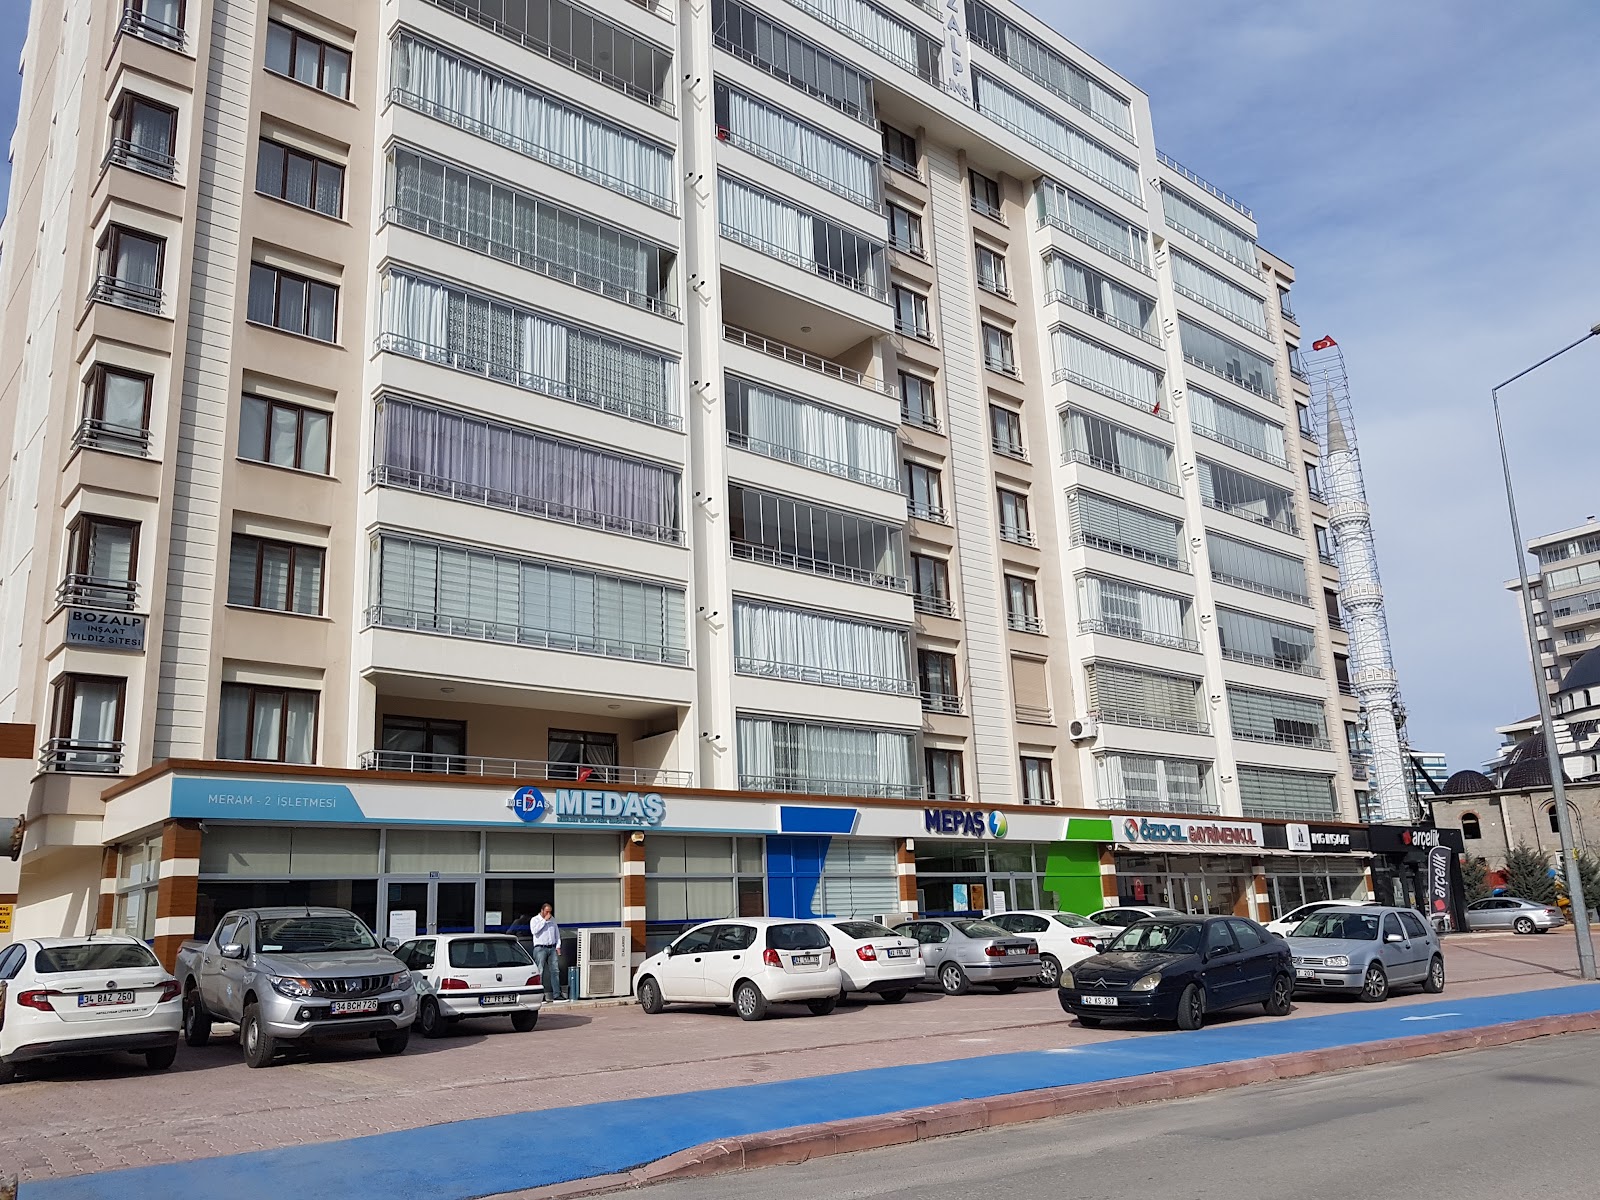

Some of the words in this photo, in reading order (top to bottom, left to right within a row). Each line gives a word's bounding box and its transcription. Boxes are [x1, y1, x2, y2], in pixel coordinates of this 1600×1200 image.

[73, 611, 141, 626] BOZALP
[208, 794, 253, 805] MERAM
[264, 796, 271, 806] 2
[277, 795, 336, 808] İŞLETMESİ
[556, 789, 663, 824] MEDAŞ
[925, 809, 985, 838] MEPAŞ
[1412, 829, 1440, 850] arçelik
[1432, 853, 1449, 898] arçelik
[84, 995, 94, 1004] 34
[97, 993, 113, 1003] BAZ
[336, 1002, 346, 1011] 34
[346, 1001, 362, 1010] BCH
